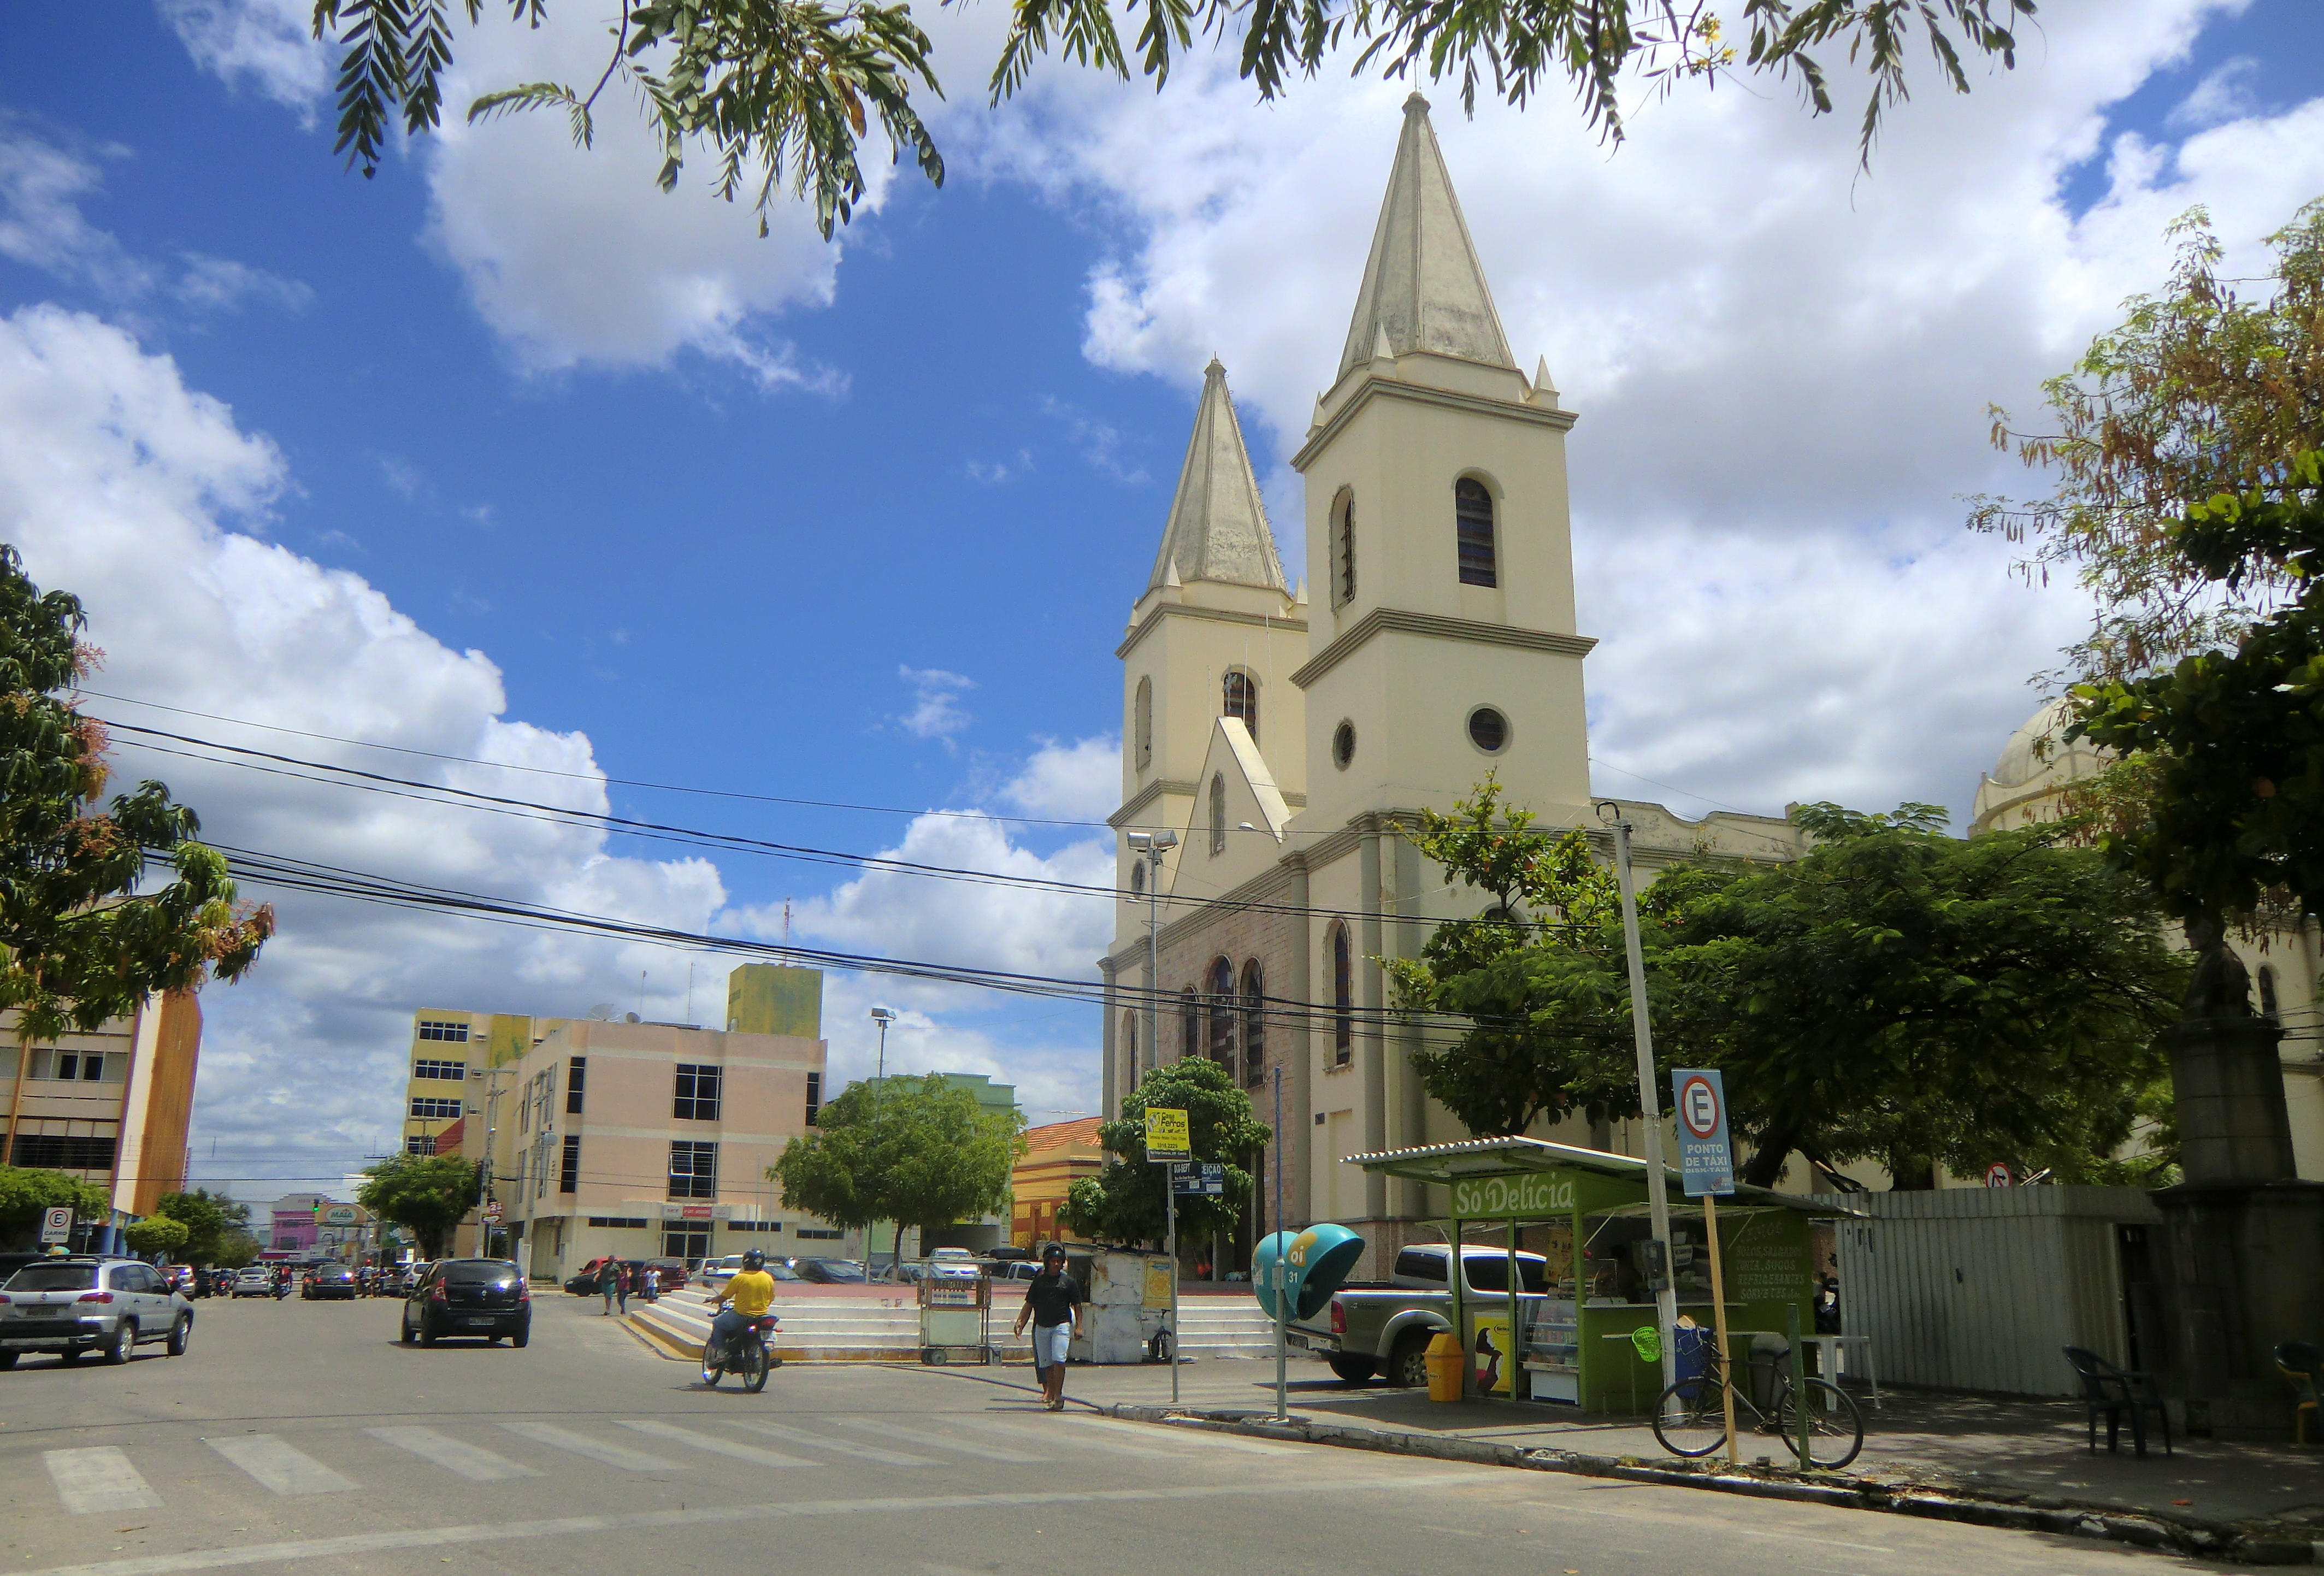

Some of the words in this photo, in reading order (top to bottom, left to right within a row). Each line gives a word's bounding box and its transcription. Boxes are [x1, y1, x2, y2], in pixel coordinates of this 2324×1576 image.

[1692, 1090, 1711, 1125] E
[1161, 1119, 1185, 1128] Ferros
[1687, 1144, 1724, 1154] PONTO
[1686, 1158, 1700, 1167] DE
[1703, 1155, 1727, 1166] TÁXI
[1174, 1162, 1191, 1174] DIX-SEPT
[1456, 1181, 1482, 1214] Só
[1485, 1172, 1574, 1212] Delícia
[55, 1214, 63, 1224] E
[1290, 1245, 1304, 1263] oi
[1288, 1271, 1298, 1283] 31
